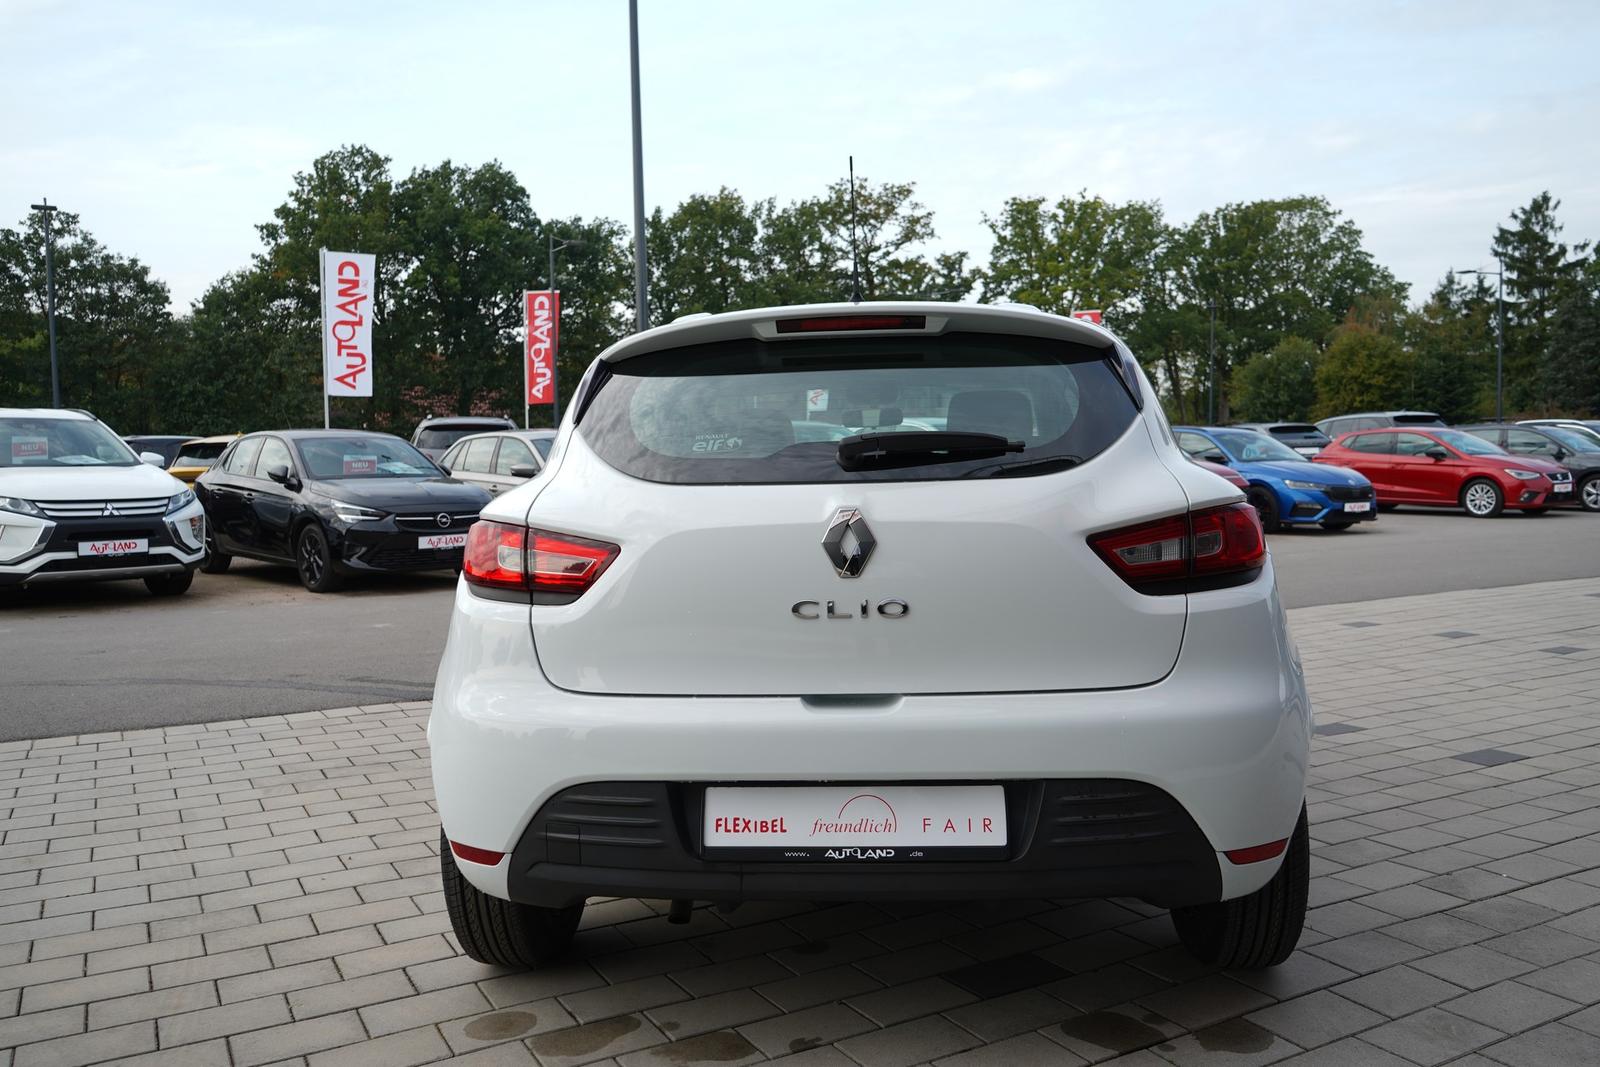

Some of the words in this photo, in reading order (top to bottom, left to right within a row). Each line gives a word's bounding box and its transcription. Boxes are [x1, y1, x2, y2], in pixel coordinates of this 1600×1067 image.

[333, 261, 367, 390] AUTOLAND
[531, 296, 552, 399] AUTOLAND
[692, 438, 724, 451] elf
[352, 461, 369, 469] NEU
[90, 541, 137, 553] AUTLAND
[427, 536, 464, 548] AUTLAND
[791, 598, 909, 619] CLIO
[715, 816, 787, 834] FLEXIBEL
[809, 817, 893, 837] freundlich
[824, 847, 895, 859] AUTOLAND
